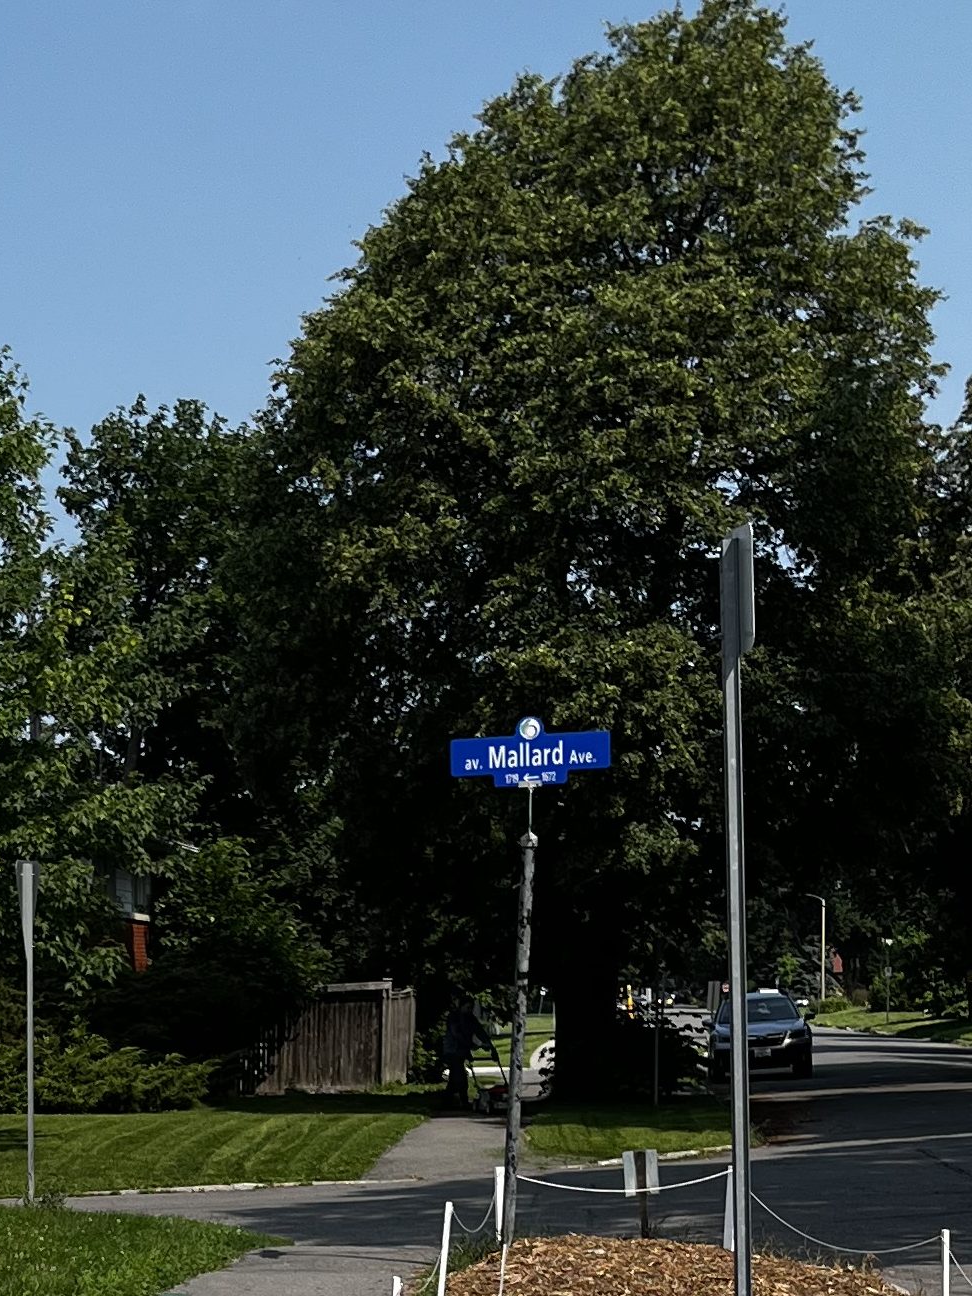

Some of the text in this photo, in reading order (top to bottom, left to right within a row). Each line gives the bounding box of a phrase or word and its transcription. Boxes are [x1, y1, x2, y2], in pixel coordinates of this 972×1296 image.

[465, 740, 597, 771] av. Mallard Ave.
